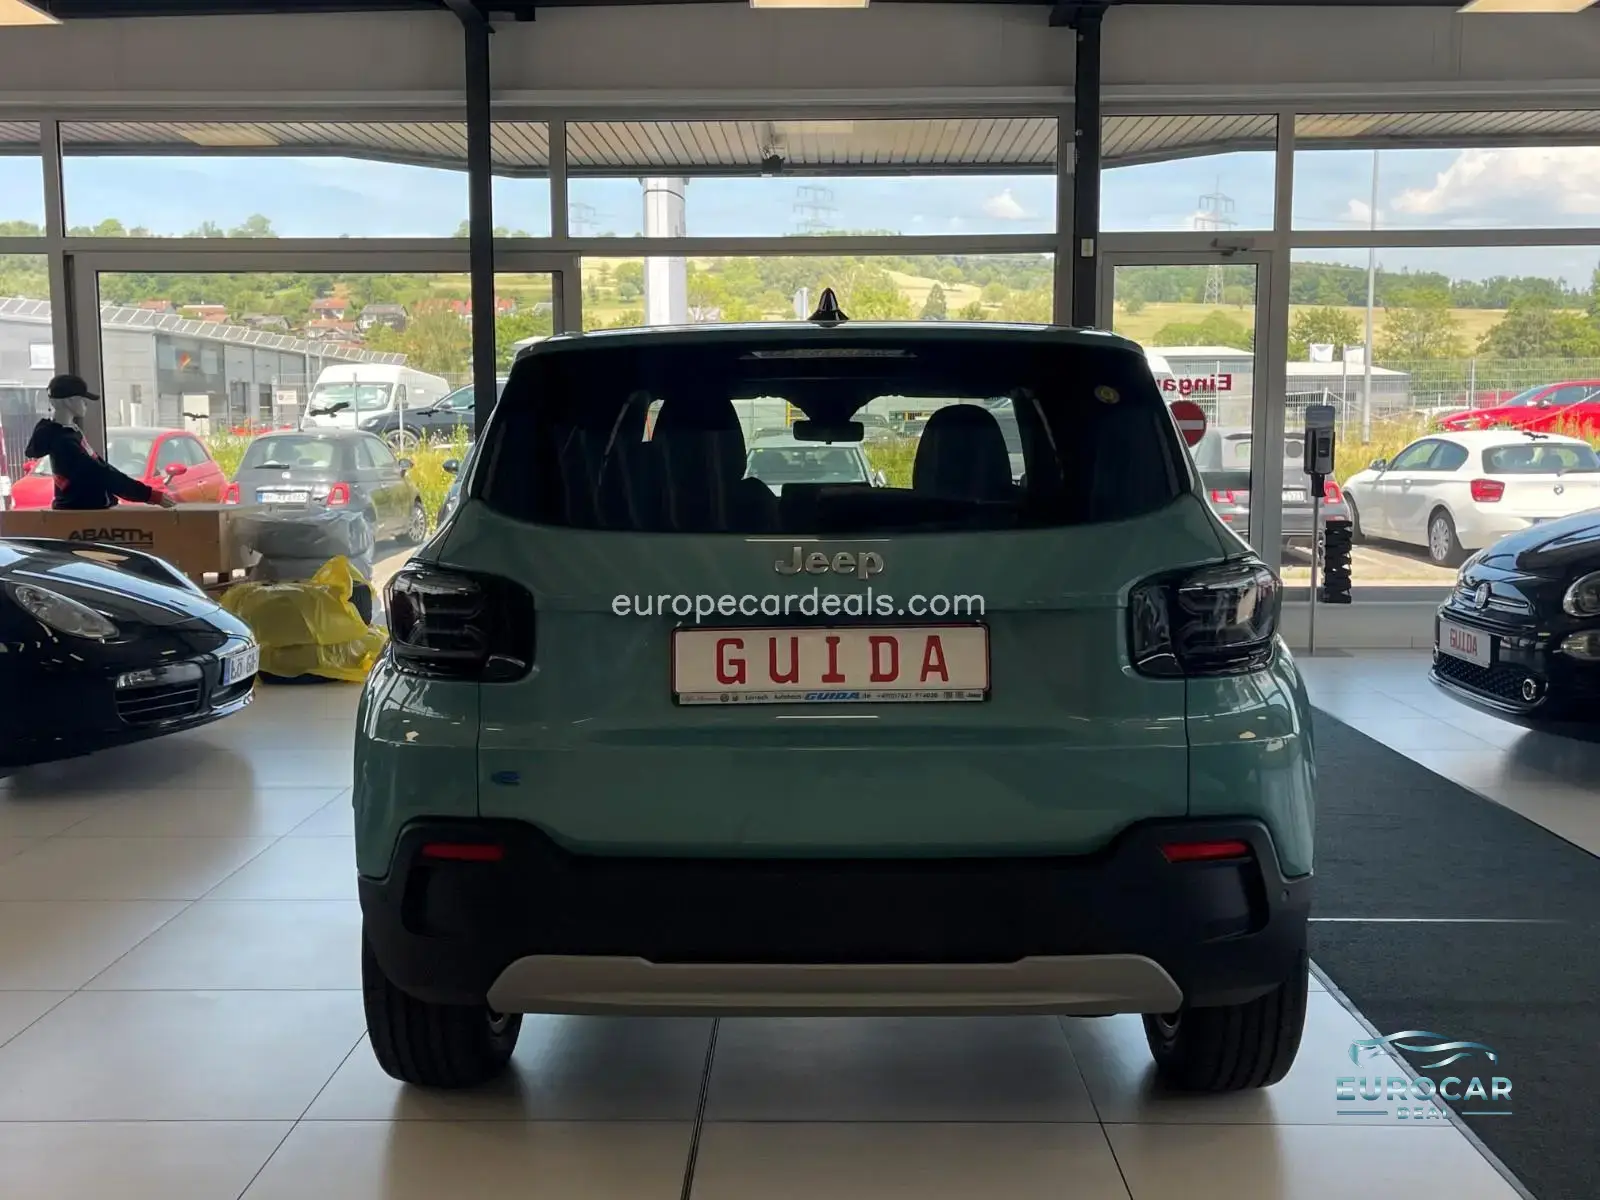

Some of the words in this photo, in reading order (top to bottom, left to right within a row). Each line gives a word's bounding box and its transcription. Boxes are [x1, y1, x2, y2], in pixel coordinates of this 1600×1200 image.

[69, 527, 154, 541] ABARTH
[775, 546, 885, 579] Jeep
[716, 635, 949, 685] GUIDA
[805, 691, 860, 701] GUIDA
